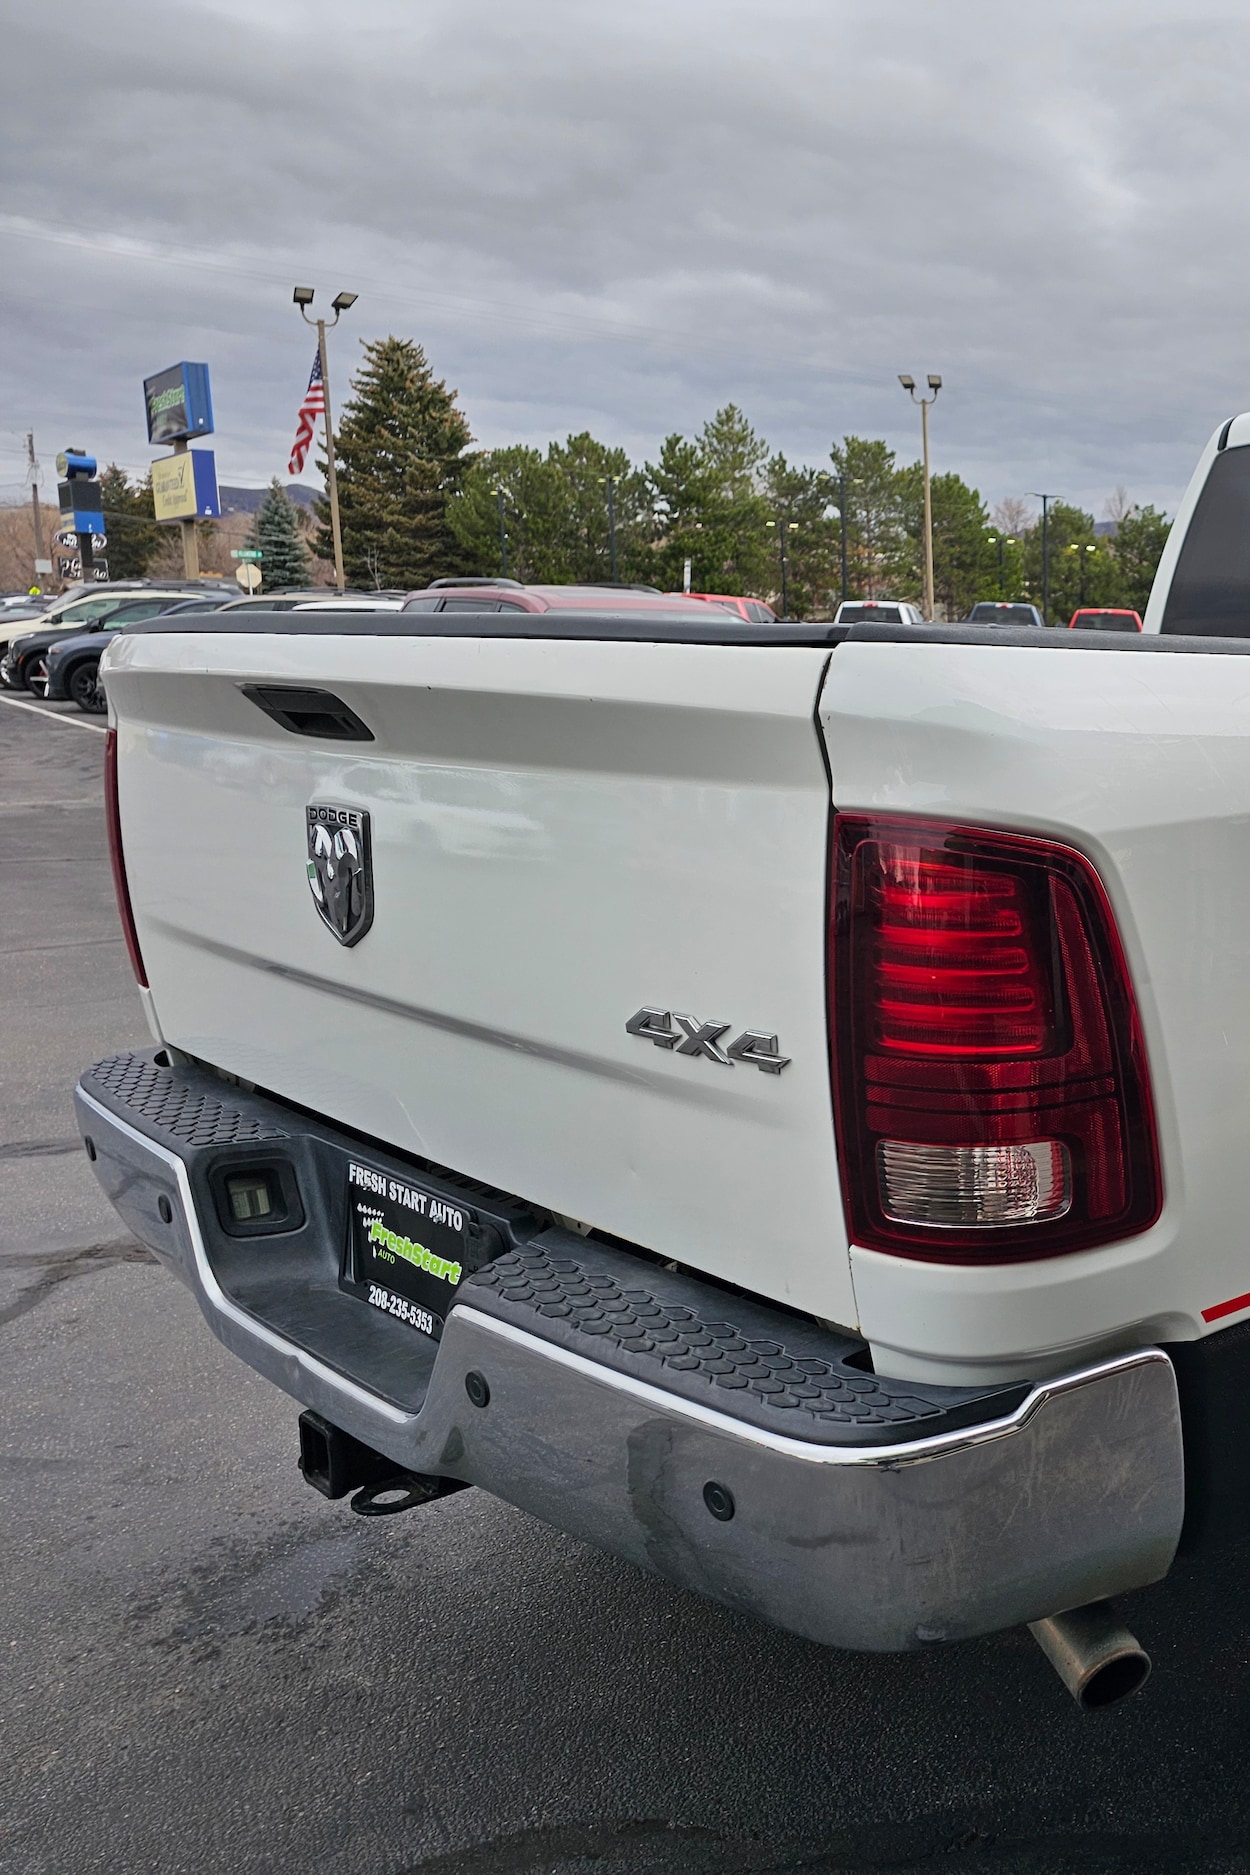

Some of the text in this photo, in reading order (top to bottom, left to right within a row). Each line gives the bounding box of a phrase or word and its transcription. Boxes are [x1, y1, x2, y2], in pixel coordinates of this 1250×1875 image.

[309, 808, 358, 827] DODGE
[348, 1163, 463, 1232] FRESH START AUTO
[370, 1222, 462, 1285] FreshStart
[377, 1248, 396, 1265] AUTO
[368, 1285, 433, 1335] 208-235-5353
